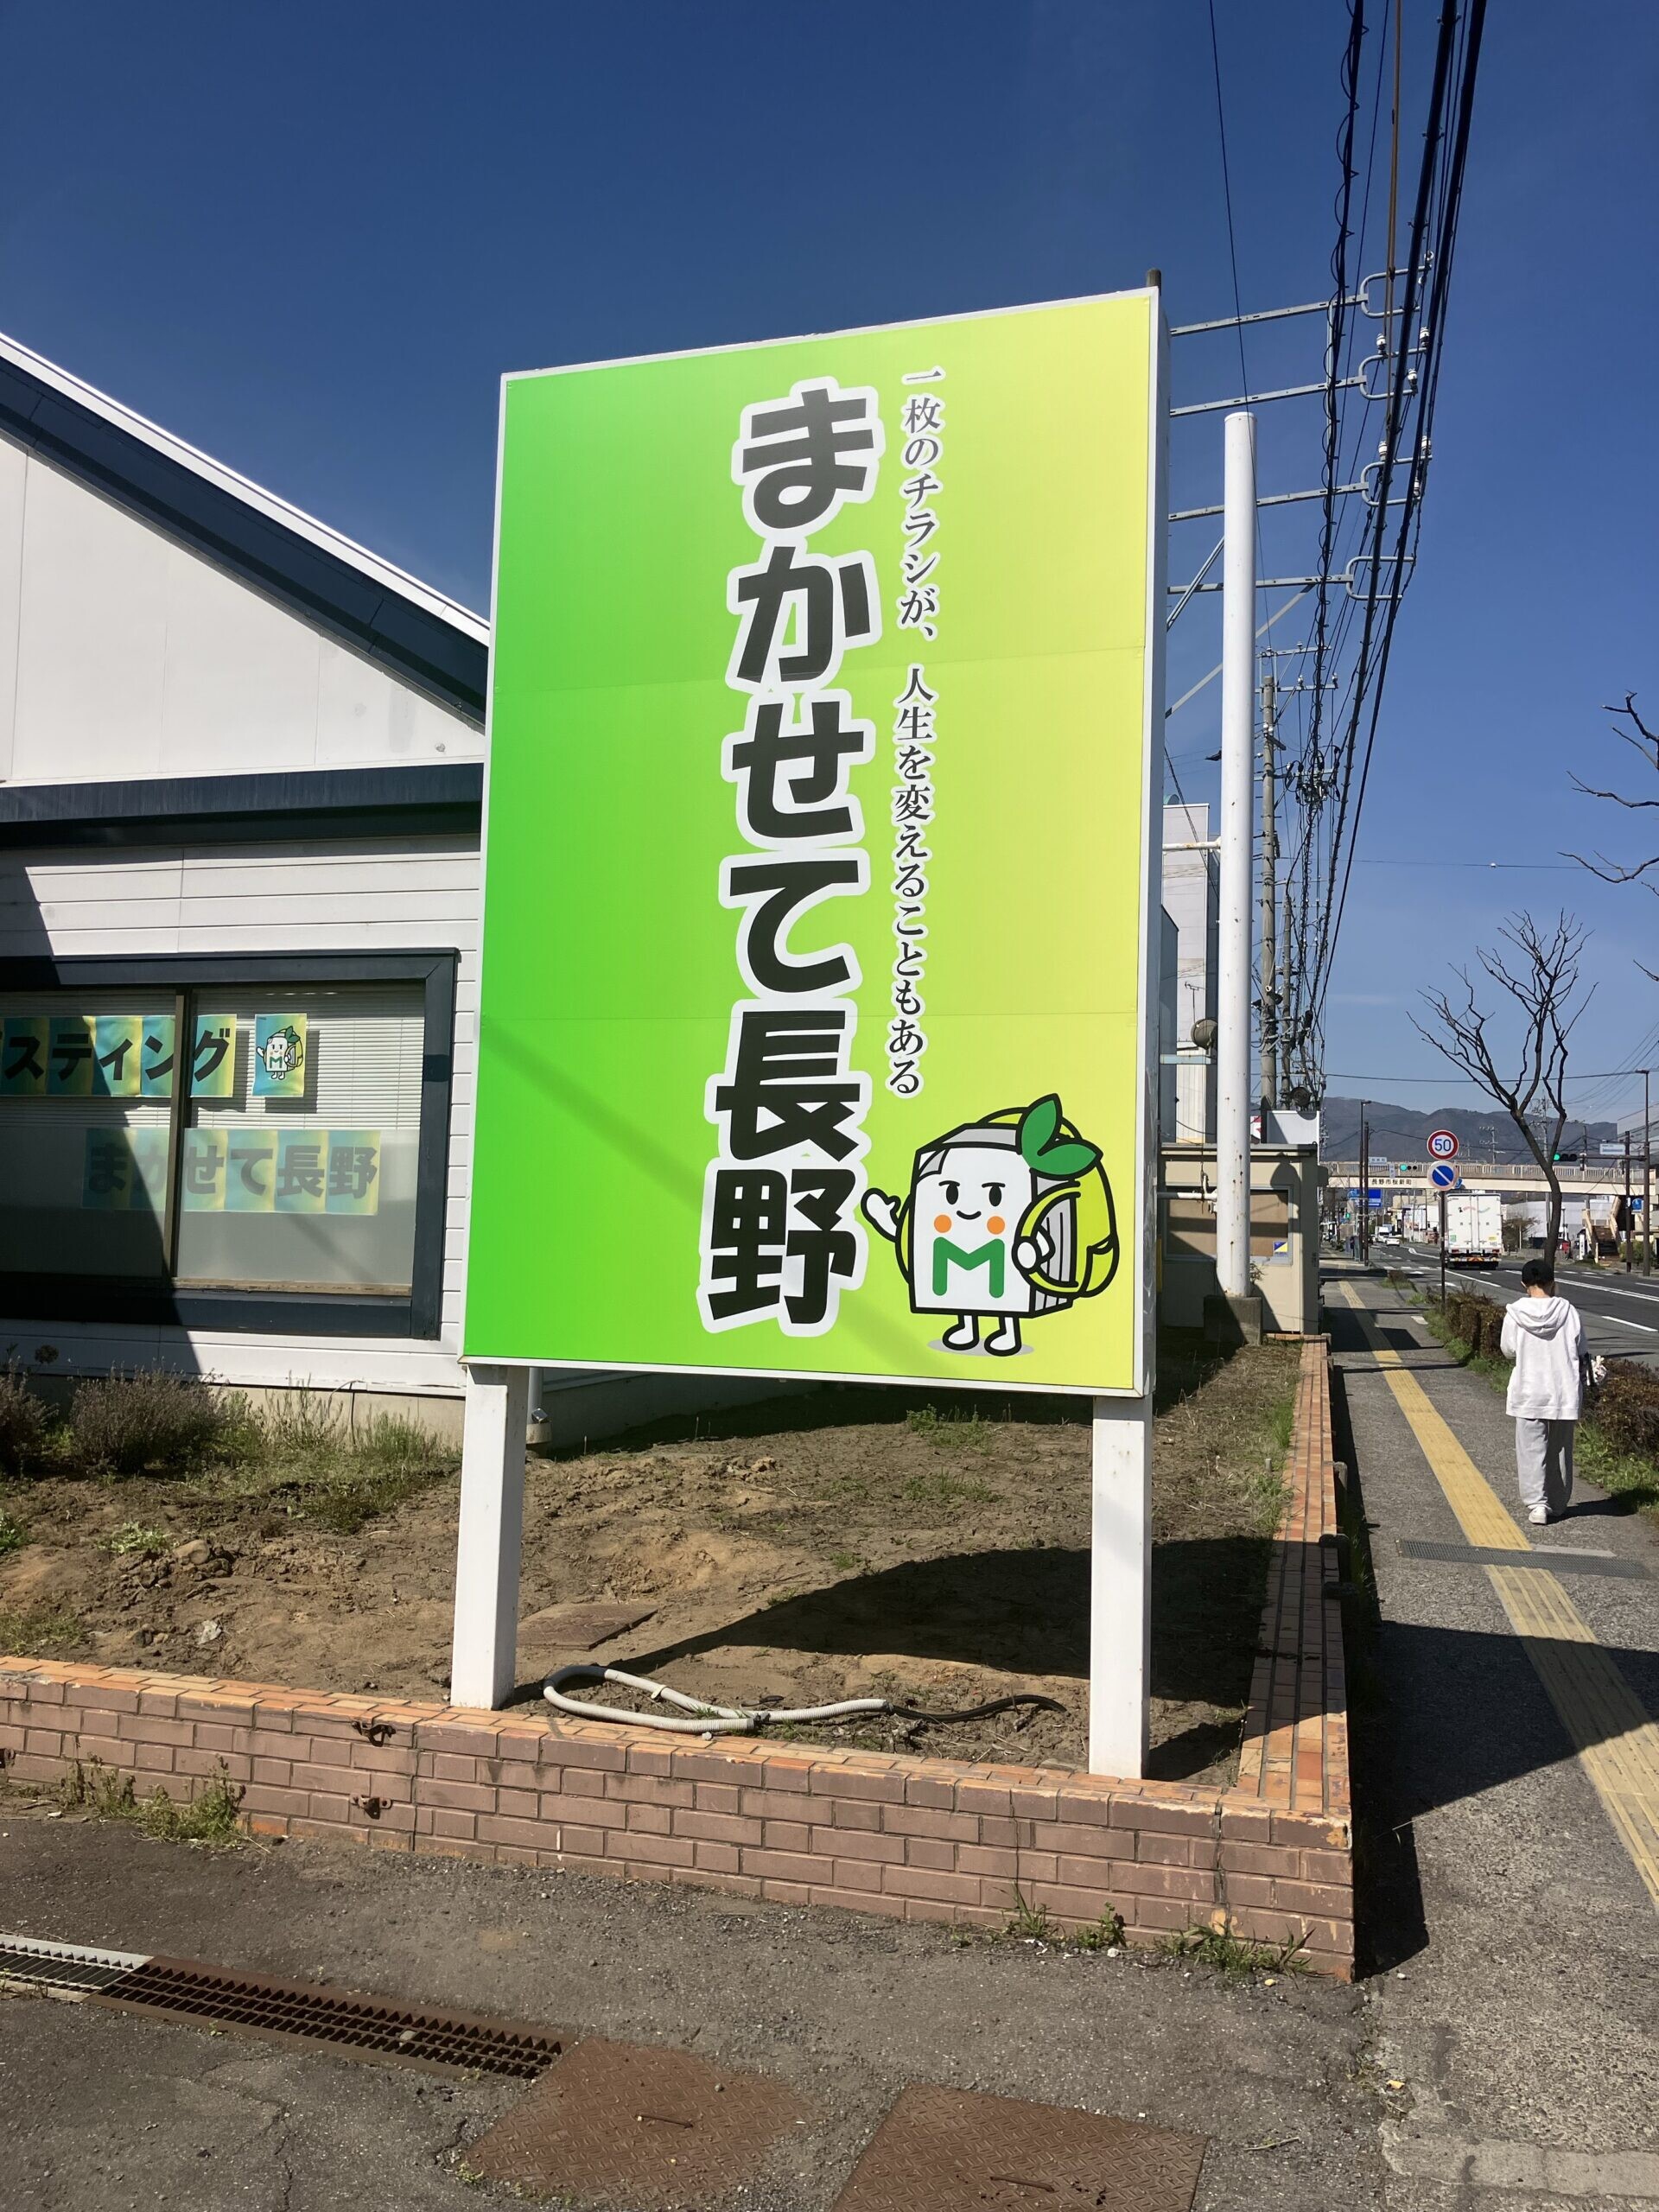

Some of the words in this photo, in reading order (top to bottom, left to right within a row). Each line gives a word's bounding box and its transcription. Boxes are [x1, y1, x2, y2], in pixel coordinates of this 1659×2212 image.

[899, 368, 944, 639] 一枚のチラシが、
[708, 387, 874, 1325] まかせて長野
[888, 668, 935, 1095] 人生を変えることもある
[0, 1027, 231, 1082] スティング
[269, 1056, 283, 1069] M
[88, 1142, 378, 1199] まかせて長野
[1433, 1138, 1452, 1152] 50
[931, 1236, 1005, 1300] M
